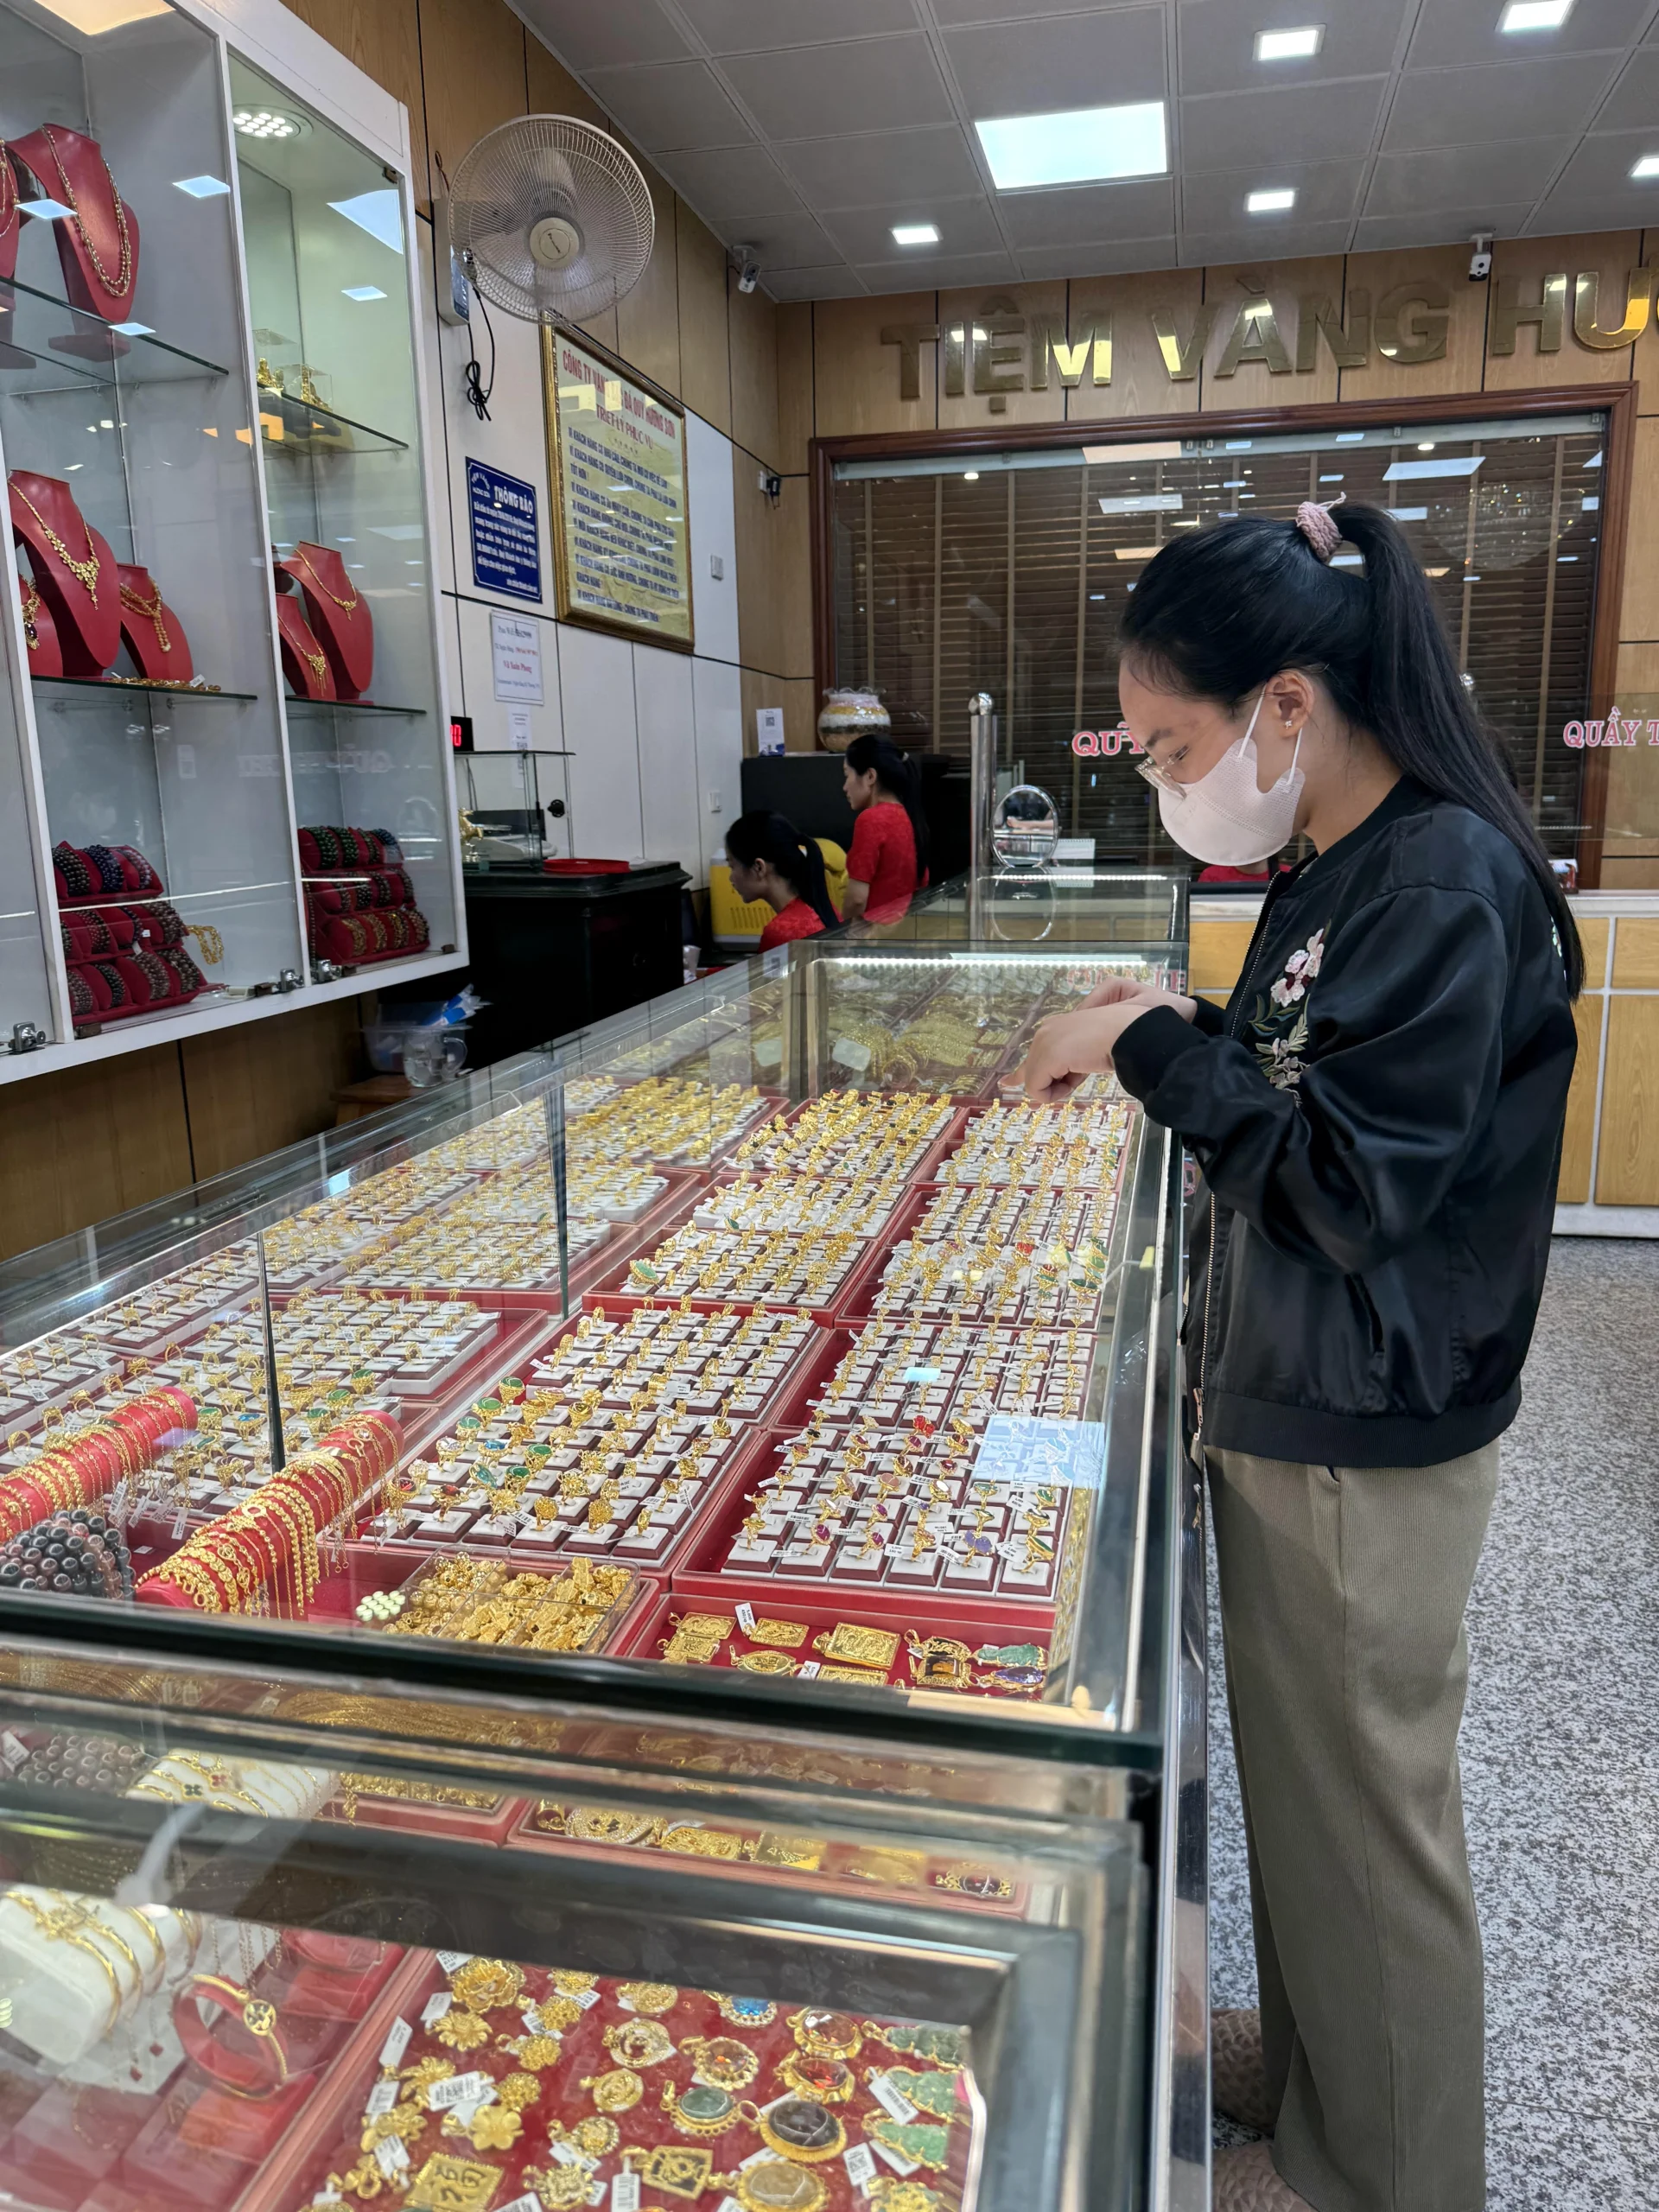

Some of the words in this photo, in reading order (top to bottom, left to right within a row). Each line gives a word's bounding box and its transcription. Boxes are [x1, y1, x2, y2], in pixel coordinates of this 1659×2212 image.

[881, 296, 1113, 413] TIỆM
[1151, 275, 1450, 382] VÀNG
[1492, 257, 1659, 356] HƯ
[494, 486, 518, 509] THÔNG
[518, 494, 533, 515] BÁO
[1563, 706, 1643, 749] QUẦY
